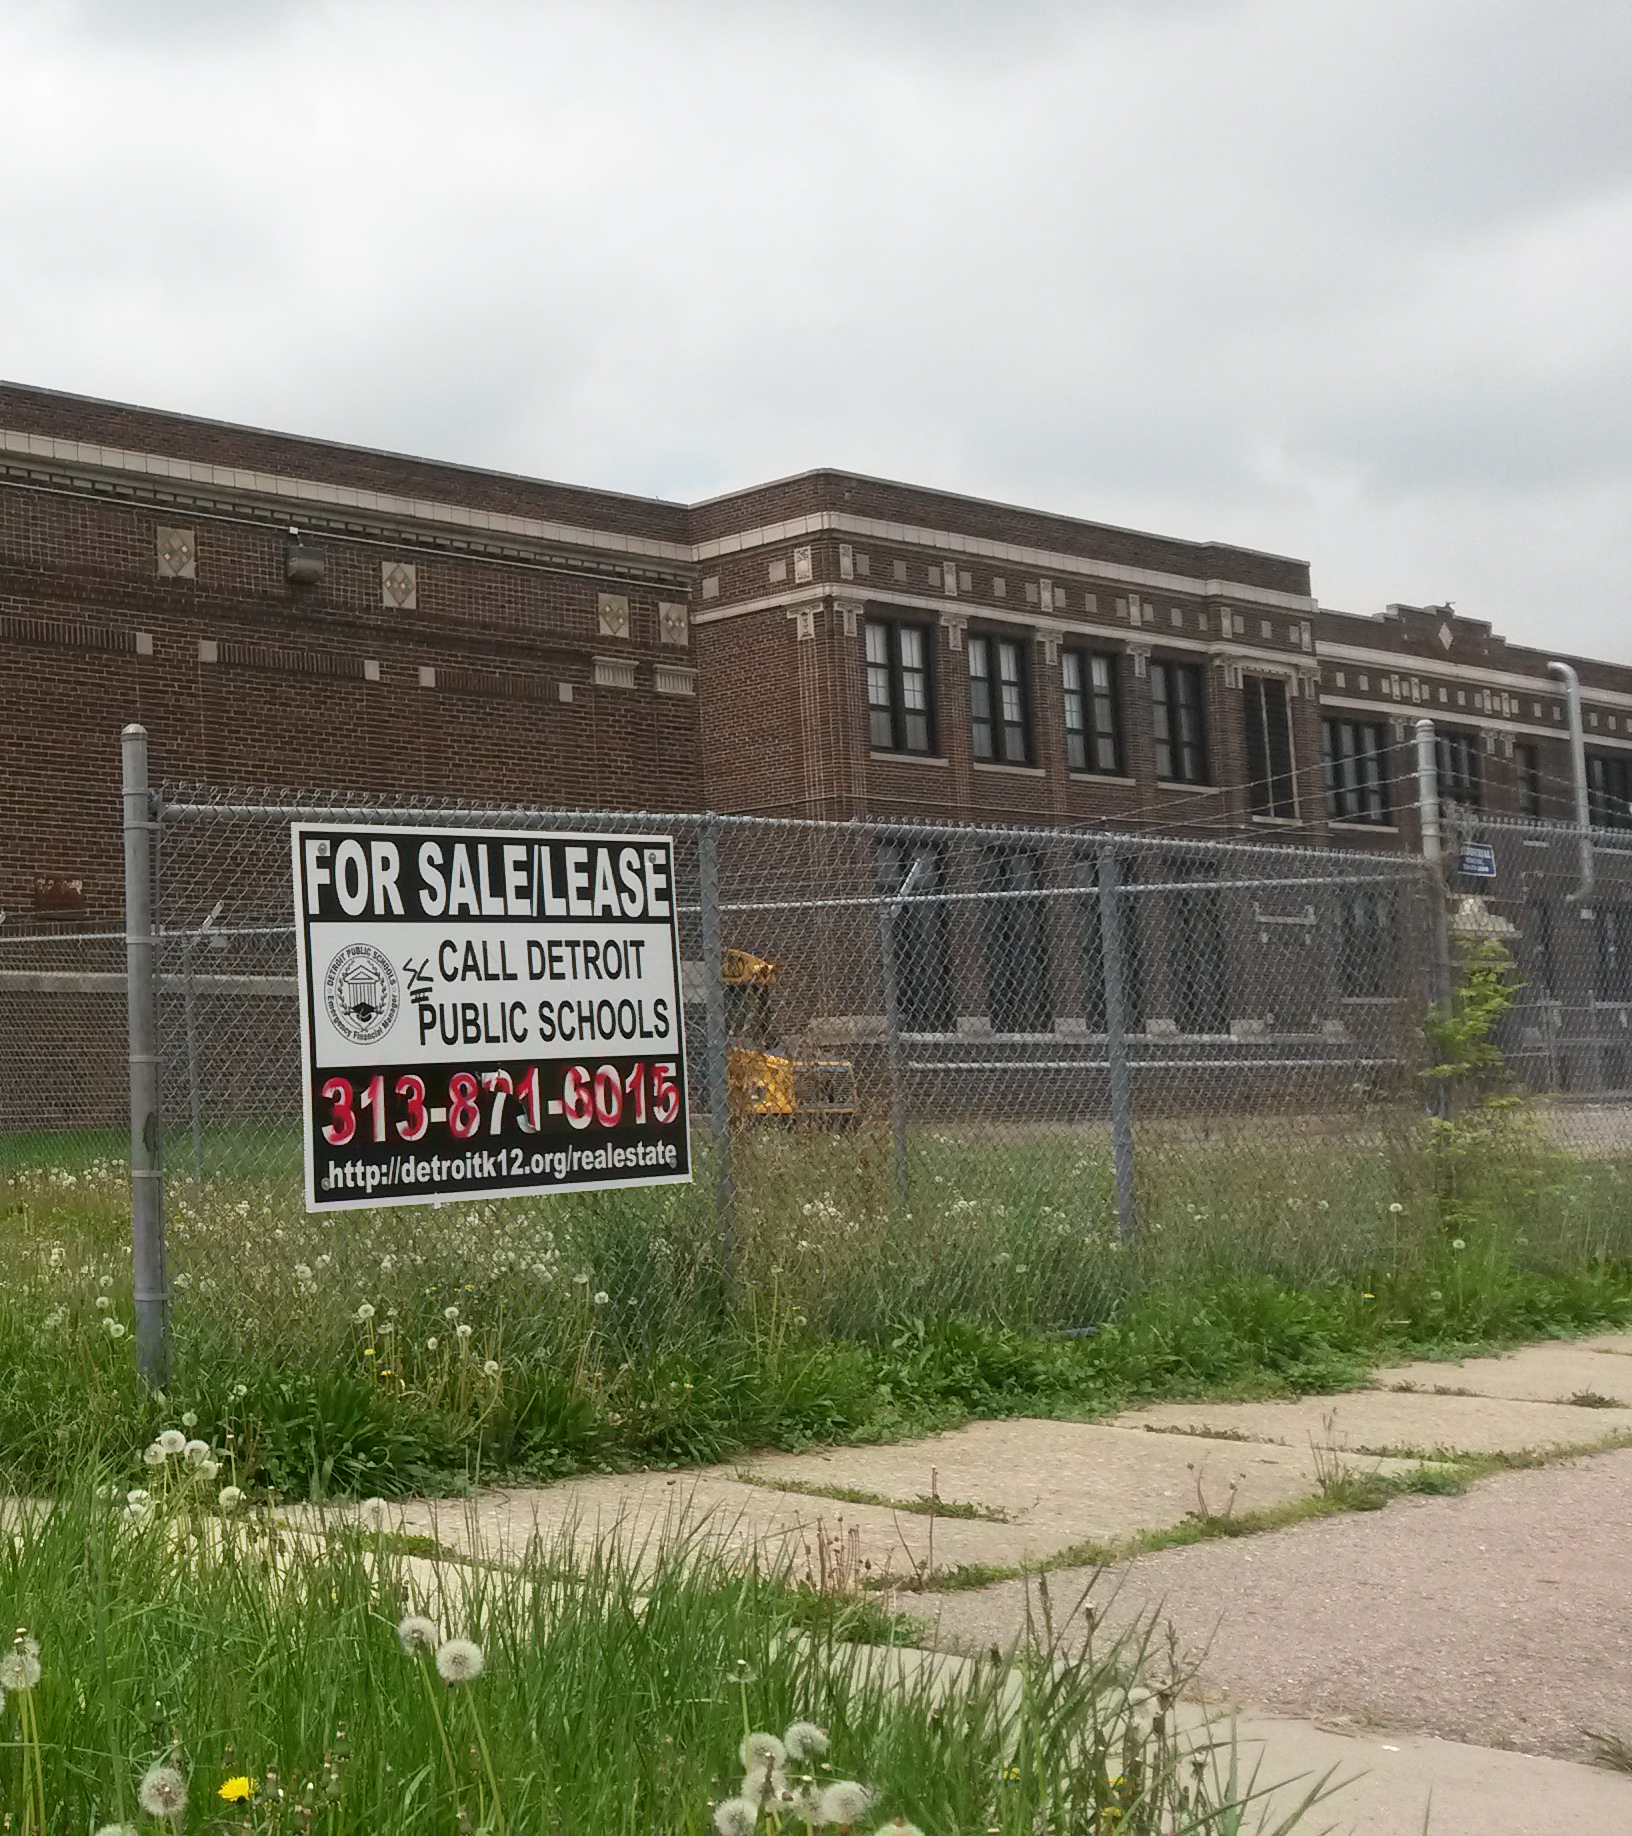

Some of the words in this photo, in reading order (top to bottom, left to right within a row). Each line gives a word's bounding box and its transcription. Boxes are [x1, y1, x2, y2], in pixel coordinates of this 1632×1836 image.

[305, 838, 405, 915] FOR
[418, 840, 671, 918] SALE/LEASE
[326, 952, 347, 987] DETROIT
[346, 946, 372, 958] PUBLIC
[372, 950, 397, 986] SCHOOLS
[438, 939, 518, 983] CALL
[526, 938, 645, 982] DETROIT
[352, 1026, 384, 1041] Financial
[418, 1001, 528, 1046] PUBLIC
[539, 999, 670, 1042] SCHOOLS
[321, 1062, 680, 1147] 313-871-6015
[327, 1140, 677, 1193] http://detroitk12.org/realestate
